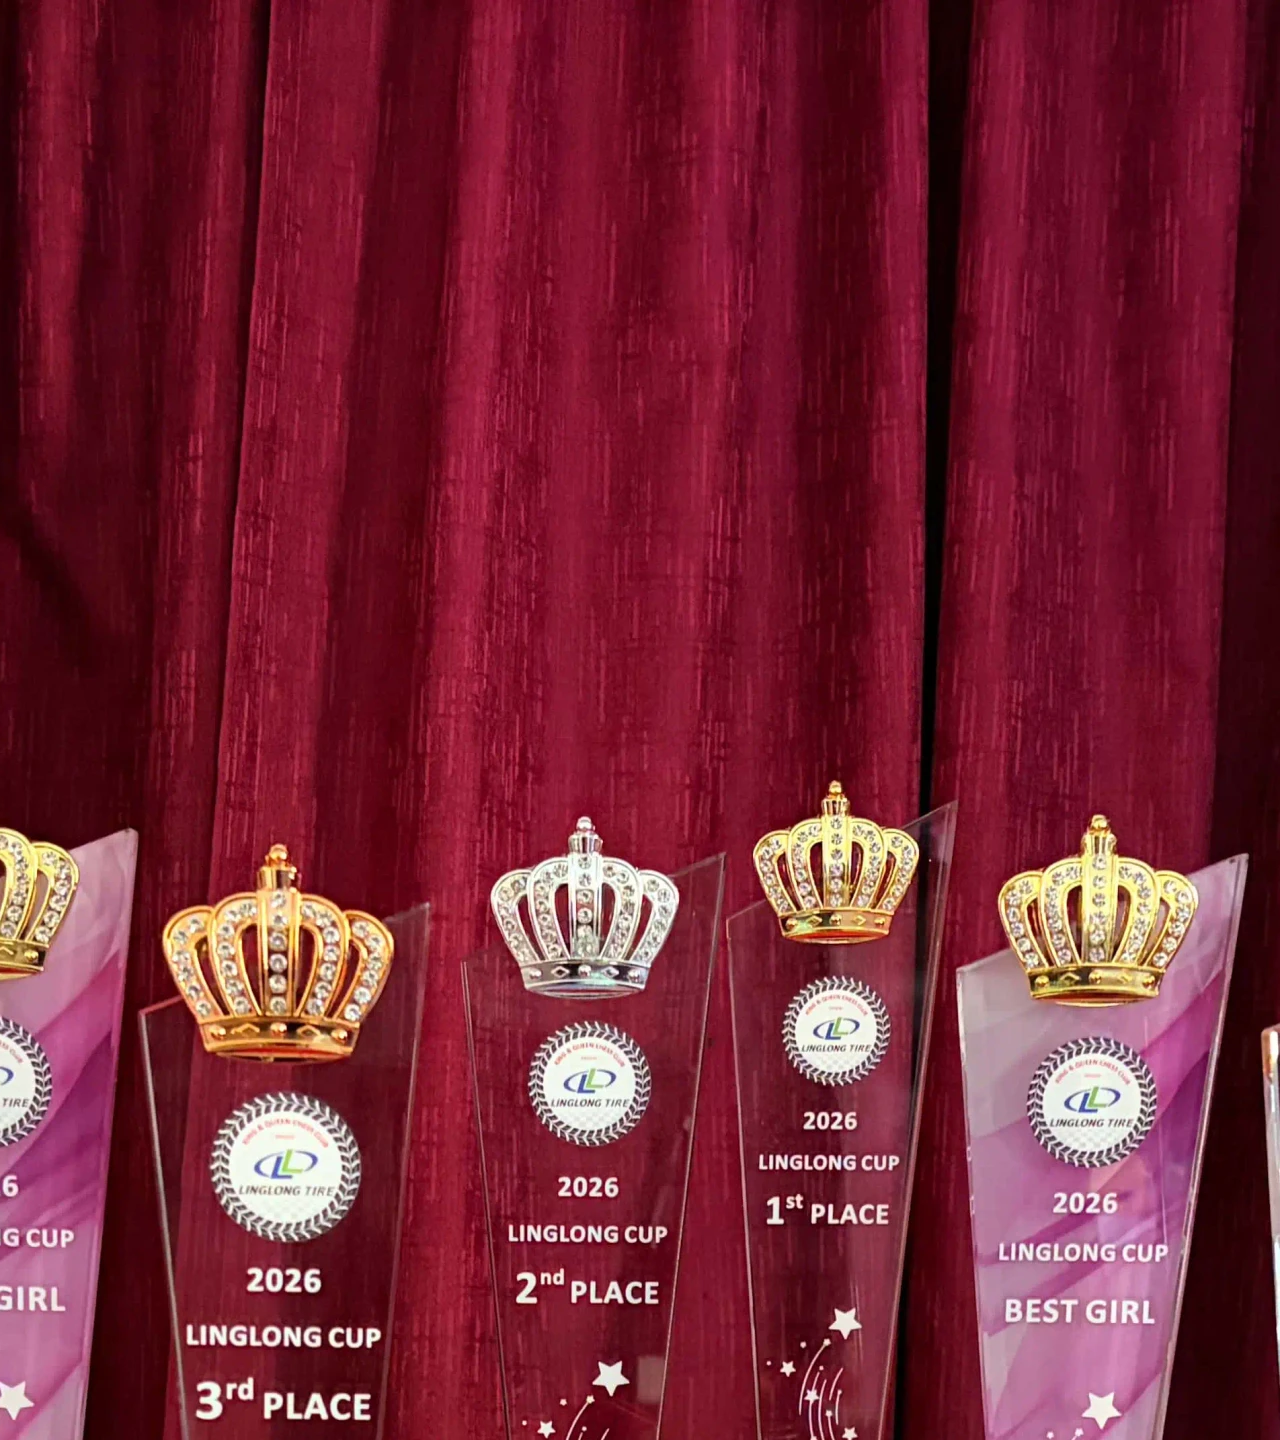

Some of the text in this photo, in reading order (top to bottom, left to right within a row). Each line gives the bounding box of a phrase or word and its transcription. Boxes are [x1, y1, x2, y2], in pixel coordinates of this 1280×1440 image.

[801, 1044, 847, 1052] LINGLONG
[2, 1098, 28, 1107] TIRE
[550, 1098, 630, 1108] LINGLONG TIRE
[803, 1112, 857, 1130] 2026
[759, 1154, 900, 1171] LINGLONG CUP
[239, 1185, 336, 1197] LINGLONG TIRE
[558, 1177, 619, 1197] 2026
[766, 1193, 889, 1225] 1st PLACE
[1053, 1192, 1118, 1214] 2026
[26, 1229, 74, 1248] CUP
[508, 1224, 668, 1244] LINGLONG CUP
[998, 1243, 1168, 1263] LINGLONG CUP
[246, 1268, 322, 1293] 2026
[516, 1269, 659, 1304] 2nd PLACE
[1005, 1299, 1155, 1324] BEST GIRL
[186, 1324, 381, 1348] LINGLONG CUP
[196, 1377, 371, 1420] 3rd PLACE
